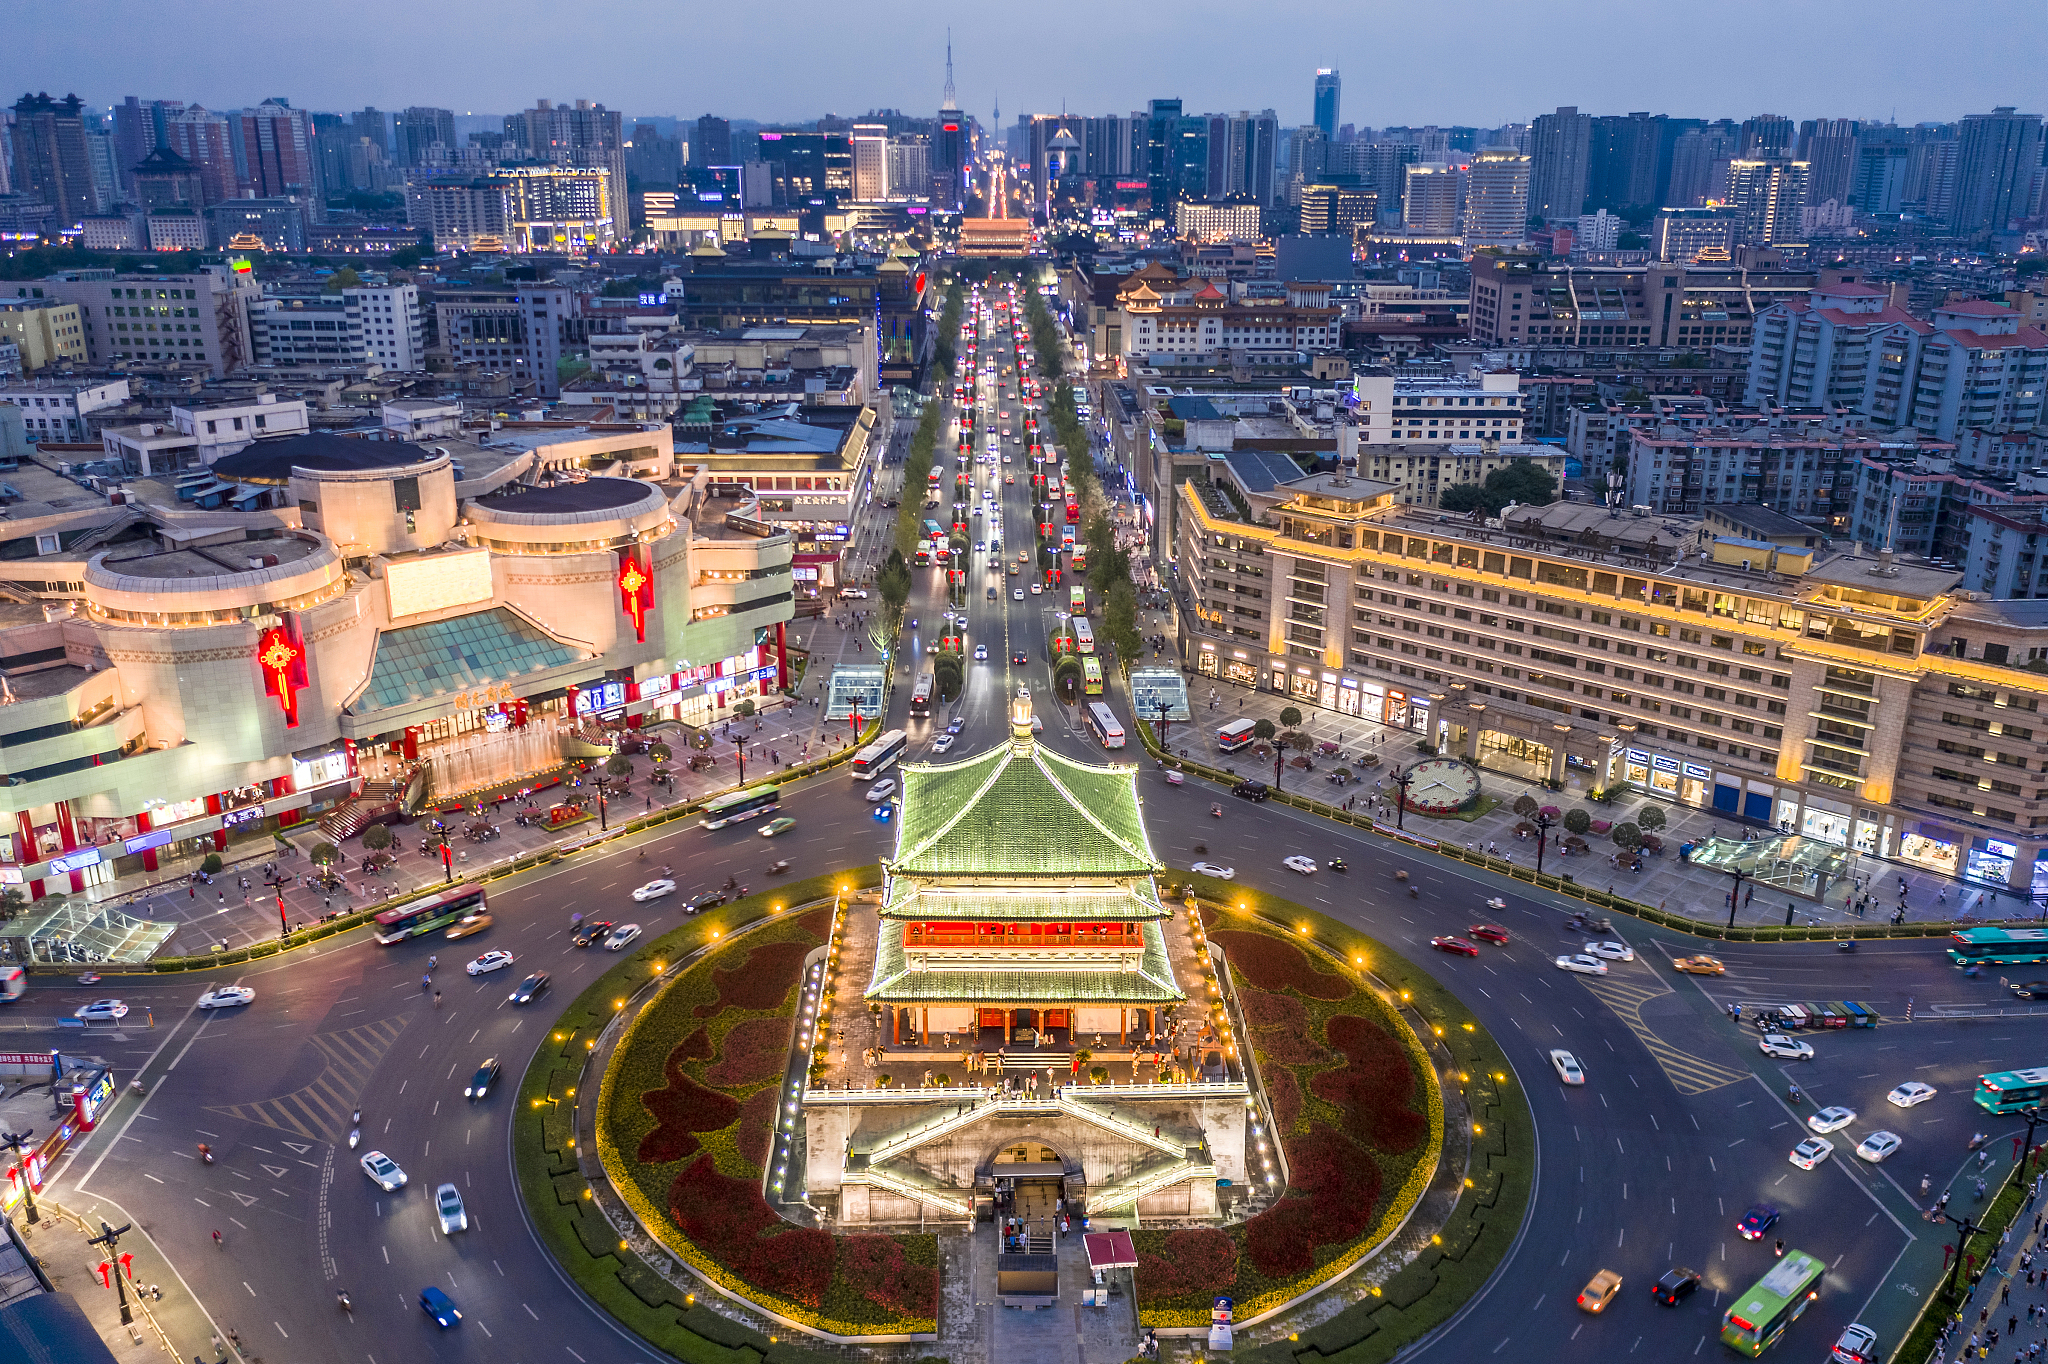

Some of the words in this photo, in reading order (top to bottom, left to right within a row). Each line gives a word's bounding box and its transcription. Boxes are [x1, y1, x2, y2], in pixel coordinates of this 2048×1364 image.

[1465, 529, 1493, 542] BELL
[1508, 537, 1551, 552] TOWER
[1566, 547, 1608, 562] HOTEL
[1625, 557, 1658, 572] XIAN
[454, 682, 515, 710] 开元商城
